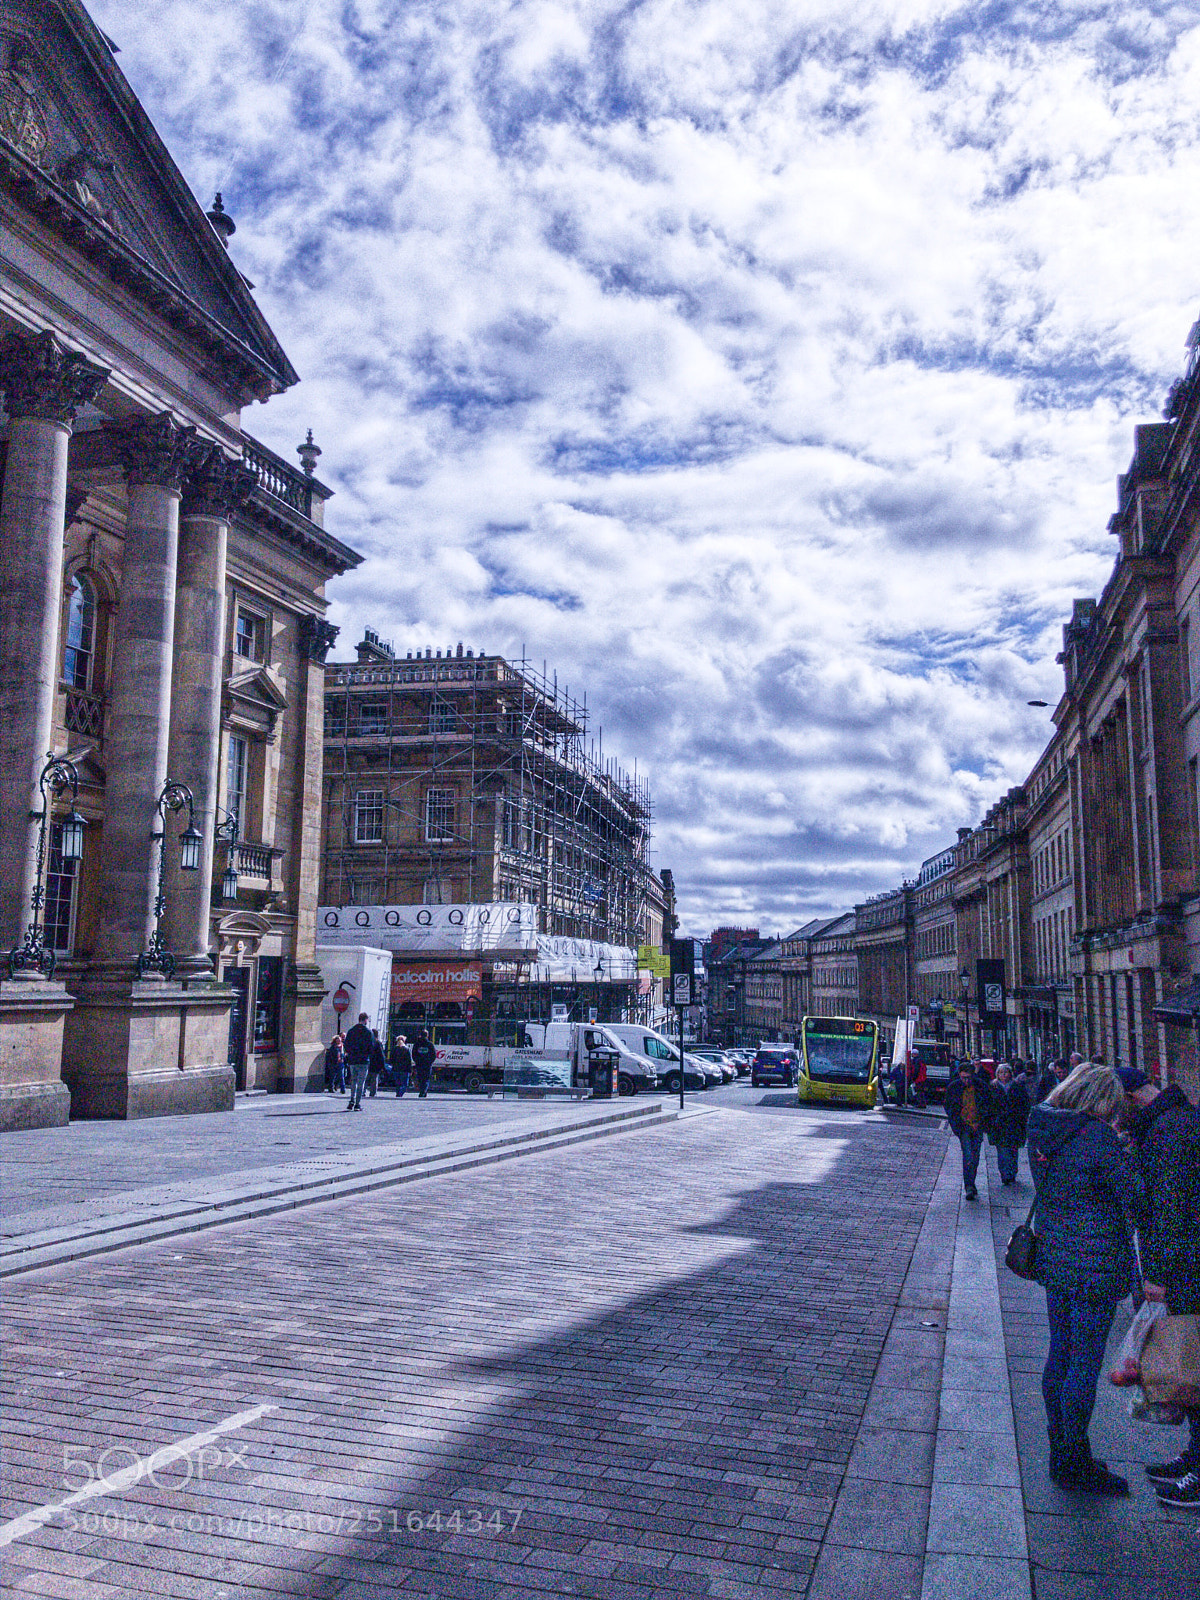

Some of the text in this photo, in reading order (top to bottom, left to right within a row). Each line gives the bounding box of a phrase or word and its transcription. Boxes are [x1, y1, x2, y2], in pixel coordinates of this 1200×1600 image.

[325, 911, 340, 928] Q
[355, 911, 371, 927] Q
[385, 910, 401, 927] Q
[416, 909, 433, 926] Q
[448, 909, 465, 926] Q
[446, 968, 481, 982] hollis
[855, 1022, 864, 1032] Q3
